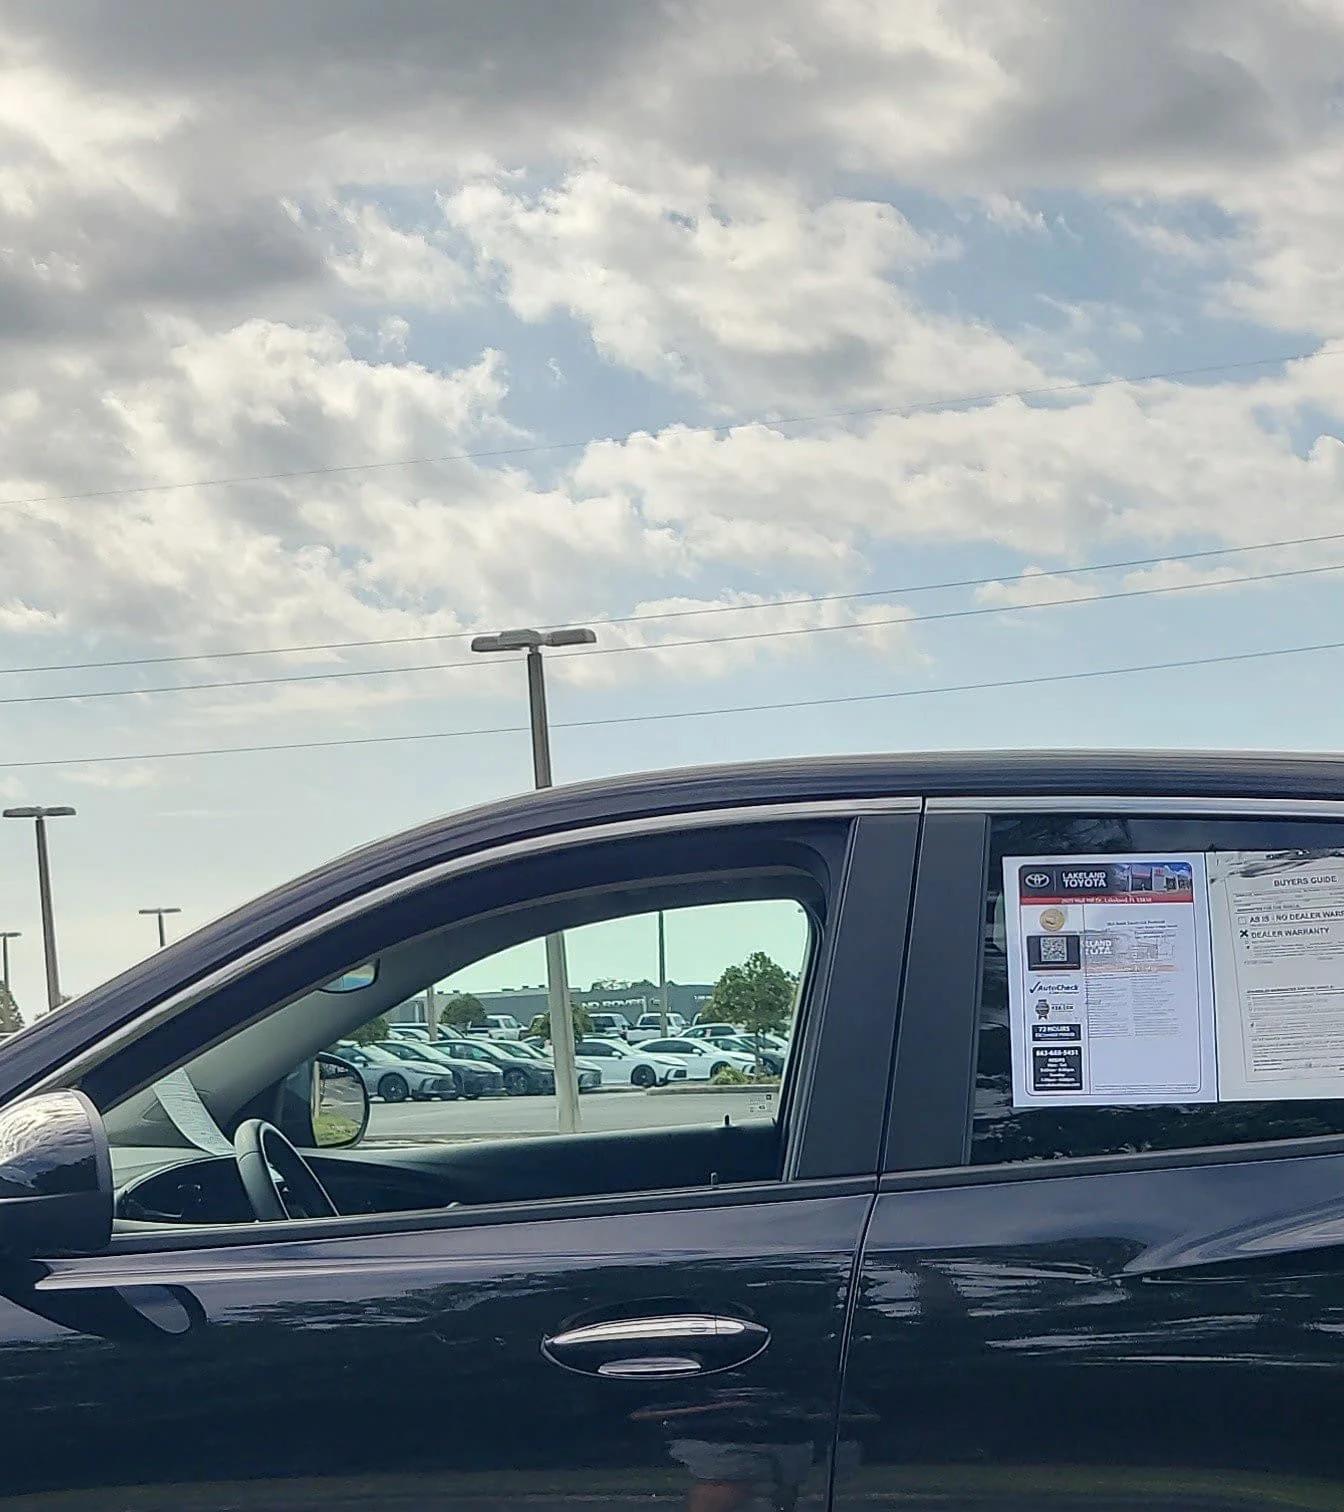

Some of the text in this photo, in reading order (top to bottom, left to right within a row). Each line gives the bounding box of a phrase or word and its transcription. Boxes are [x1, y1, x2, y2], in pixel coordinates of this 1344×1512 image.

[1062, 871, 1106, 880] LAKELAND
[1064, 879, 1106, 887] TOYOTA
[1273, 875, 1338, 888] BUYERS GUIDE
[1289, 912, 1321, 921] DEALER
[1251, 927, 1330, 939] DEALER WARRANTY
